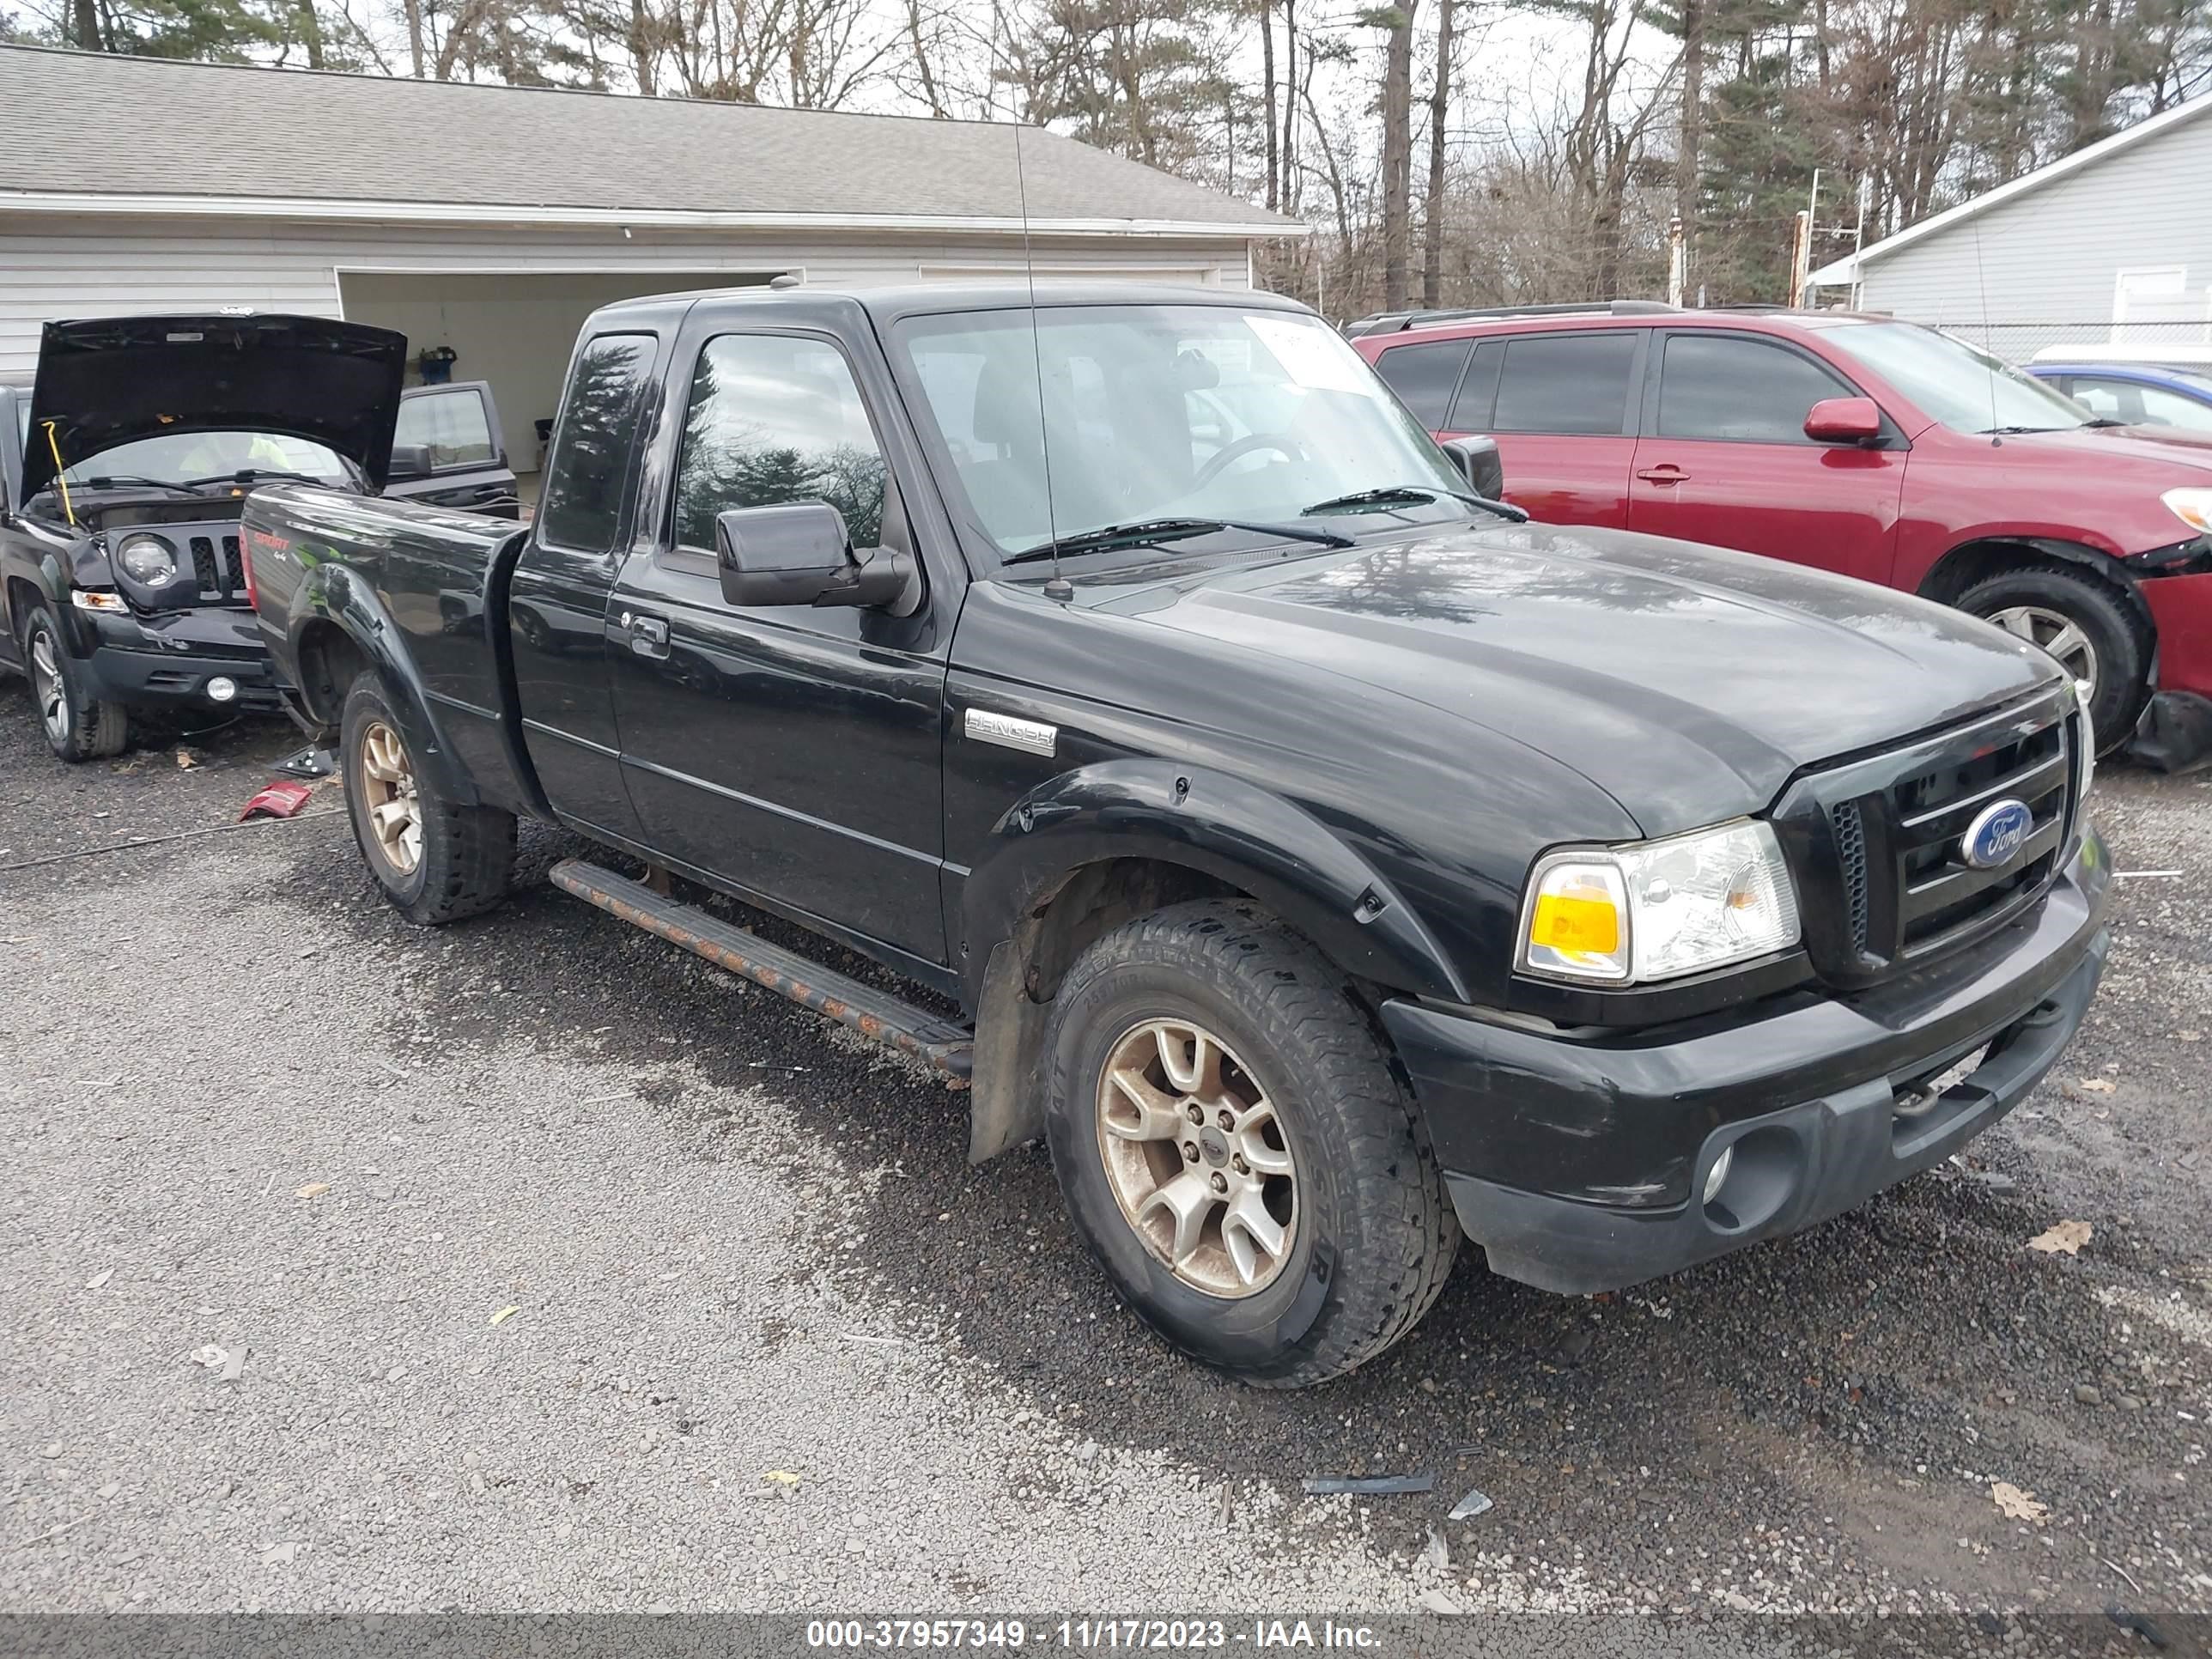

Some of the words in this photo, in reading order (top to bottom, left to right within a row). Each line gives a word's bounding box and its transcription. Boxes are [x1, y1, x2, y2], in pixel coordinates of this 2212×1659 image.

[253, 532, 289, 550] SPORT
[965, 712, 1054, 746] RANGER
[1988, 813, 2023, 856] Ford
